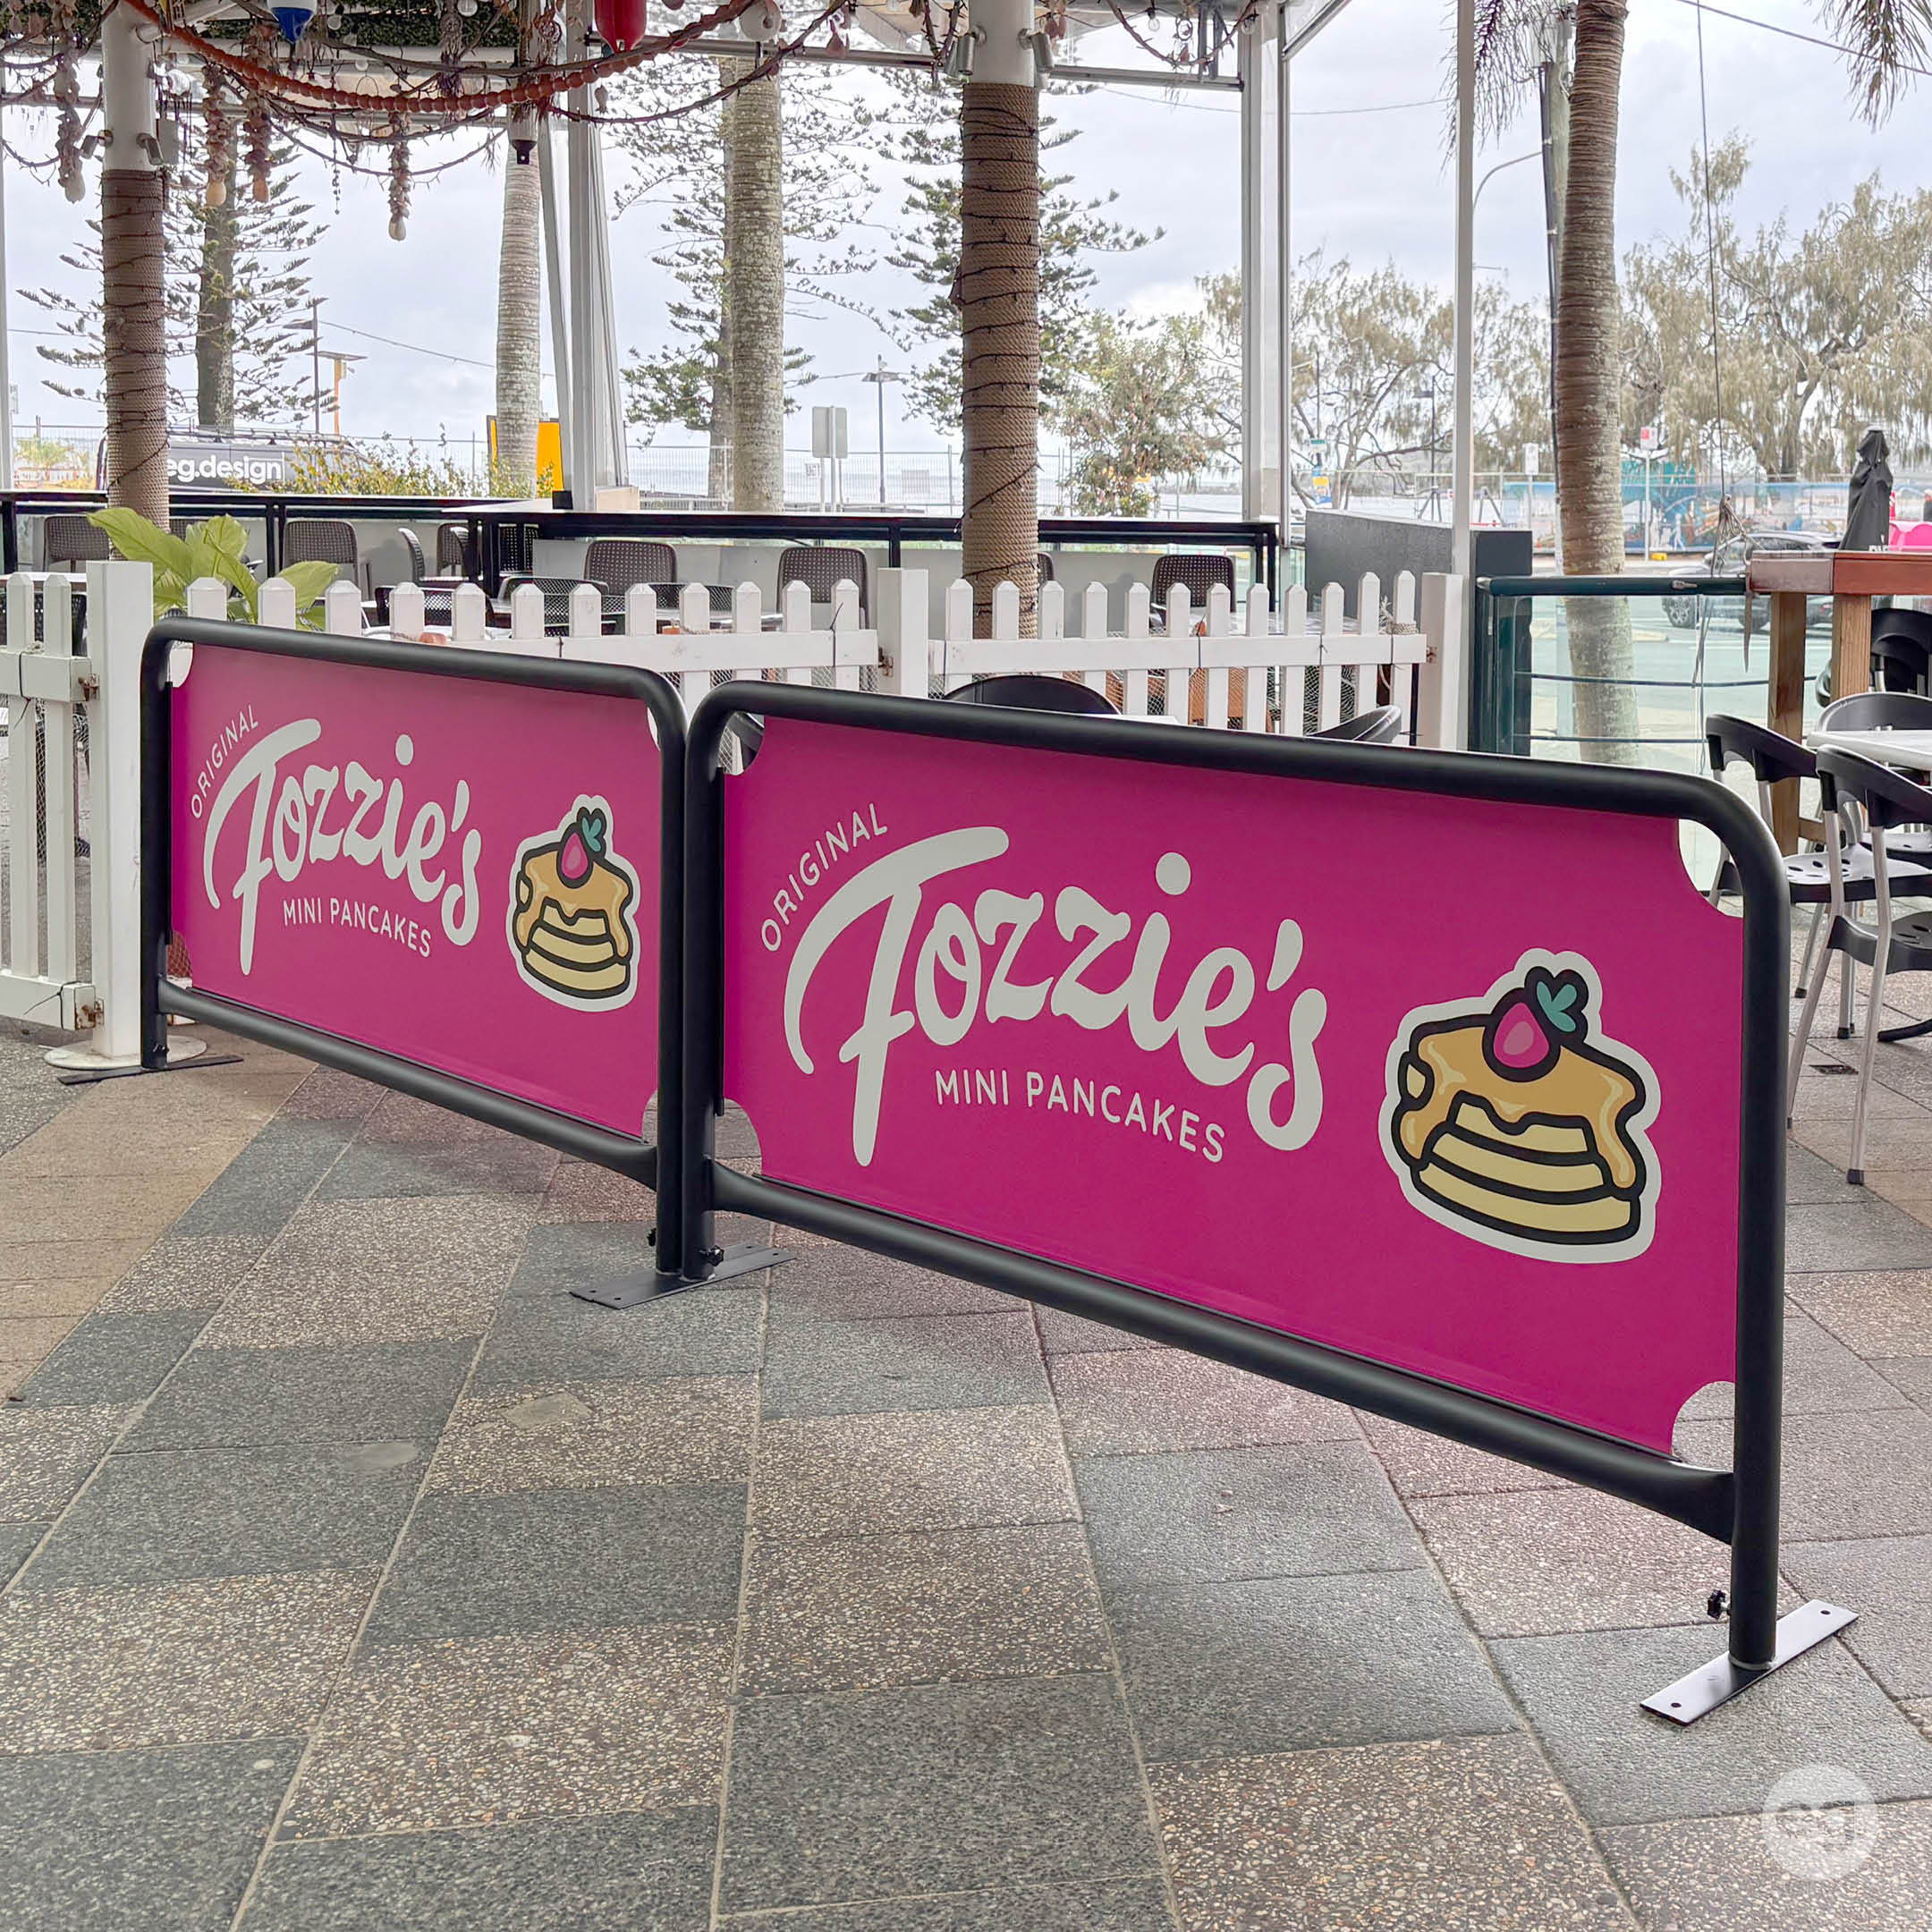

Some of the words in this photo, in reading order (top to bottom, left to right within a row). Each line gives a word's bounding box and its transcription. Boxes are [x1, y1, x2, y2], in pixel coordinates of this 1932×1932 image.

[191, 704, 259, 818] ORIGINAL
[283, 897, 322, 926] MINI
[330, 897, 431, 958] PANCAKES
[760, 803, 888, 952] ORIGINAL
[935, 1069, 1009, 1106] MINI
[1026, 1071, 1225, 1163] PANCAKES
